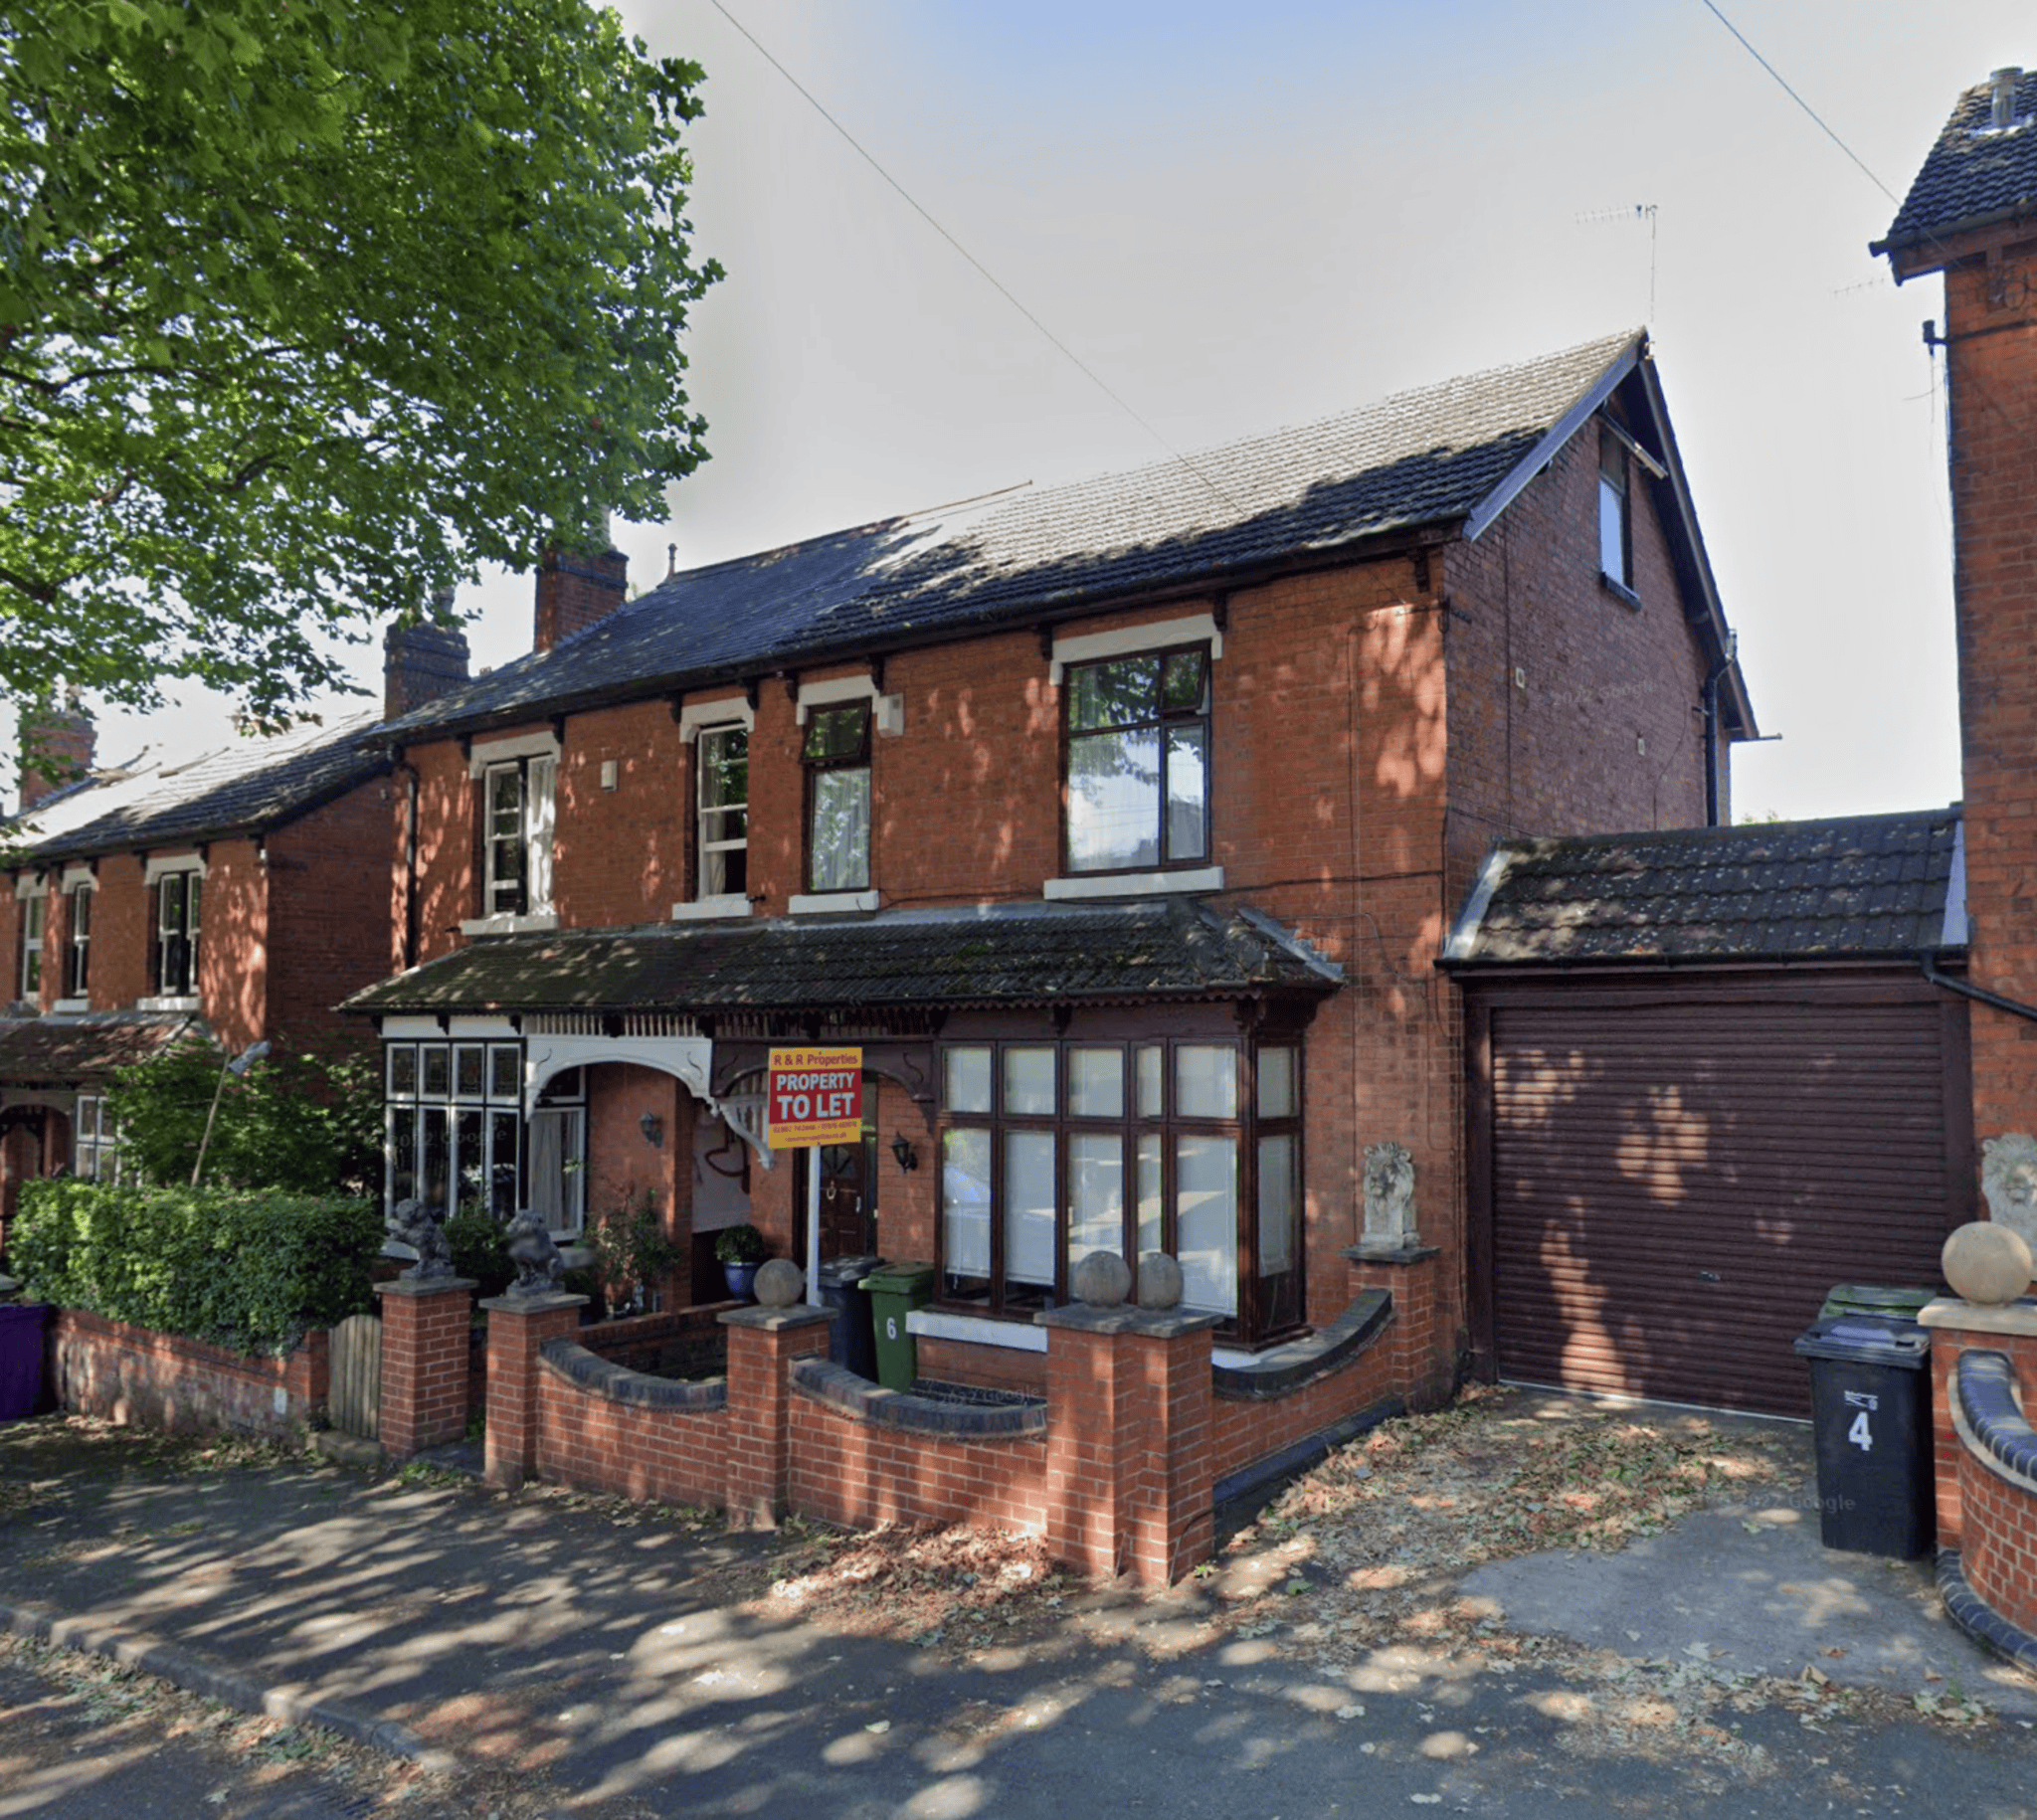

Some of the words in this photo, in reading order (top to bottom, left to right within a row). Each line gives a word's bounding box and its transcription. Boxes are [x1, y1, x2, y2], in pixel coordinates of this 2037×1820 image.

[773, 1054, 782, 1066] R
[785, 1054, 794, 1066] &
[796, 1054, 804, 1066] R
[807, 1053, 858, 1067] Properties
[776, 1072, 855, 1091] PROPERTY
[777, 1094, 811, 1120] TO
[816, 1092, 855, 1118] LET
[886, 1317, 897, 1340] 6
[1848, 1411, 1873, 1451] 4
